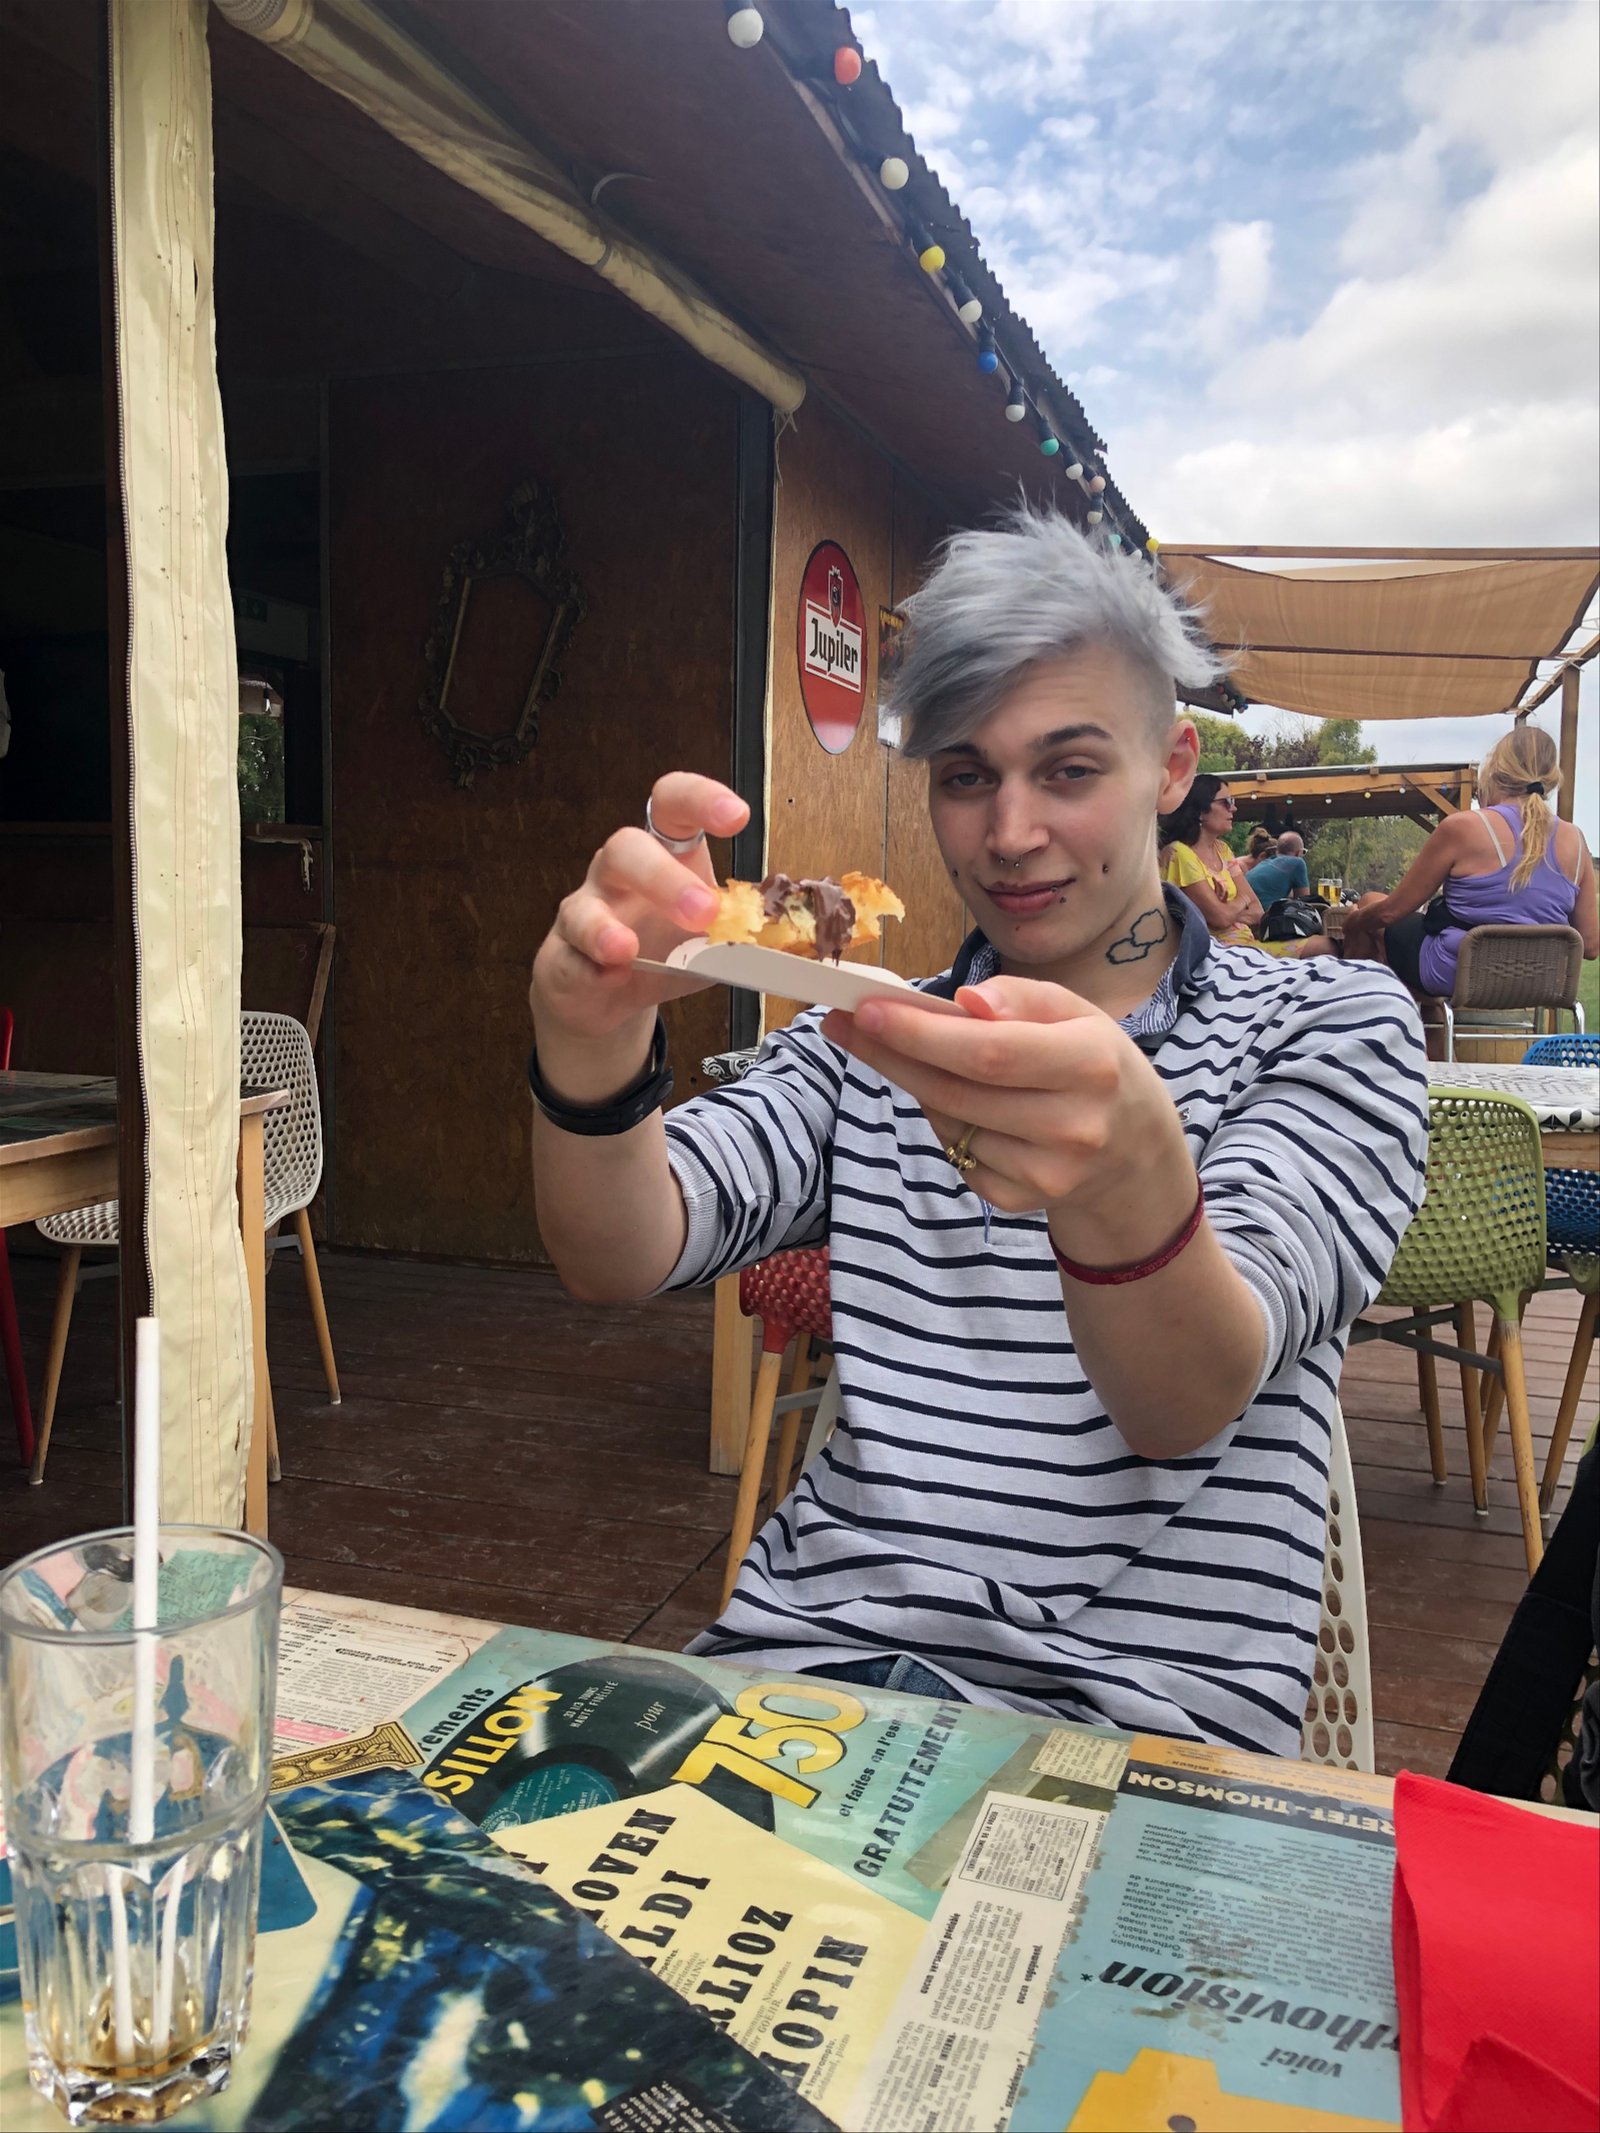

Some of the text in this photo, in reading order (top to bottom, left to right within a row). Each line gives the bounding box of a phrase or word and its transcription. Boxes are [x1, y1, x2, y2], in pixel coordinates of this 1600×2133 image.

[809, 617, 858, 673] Jupiler
[569, 1680, 619, 1728] HAUTE FIDÉLITÉ
[634, 1700, 668, 1733] pour
[671, 1682, 867, 1809] 750
[839, 1803, 854, 1817] et
[849, 1766, 875, 1803] faites
[871, 1747, 886, 1763] en
[853, 1701, 962, 1878] GRATUITEMENT
[1127, 1769, 1395, 1837] RETET-THOMSON
[620, 1870, 711, 1968] LDI
[1111, 1939, 1160, 1954] Télévision
[1264, 2047, 1344, 2078] voici
[641, 2092, 676, 2124] Ludmilla
